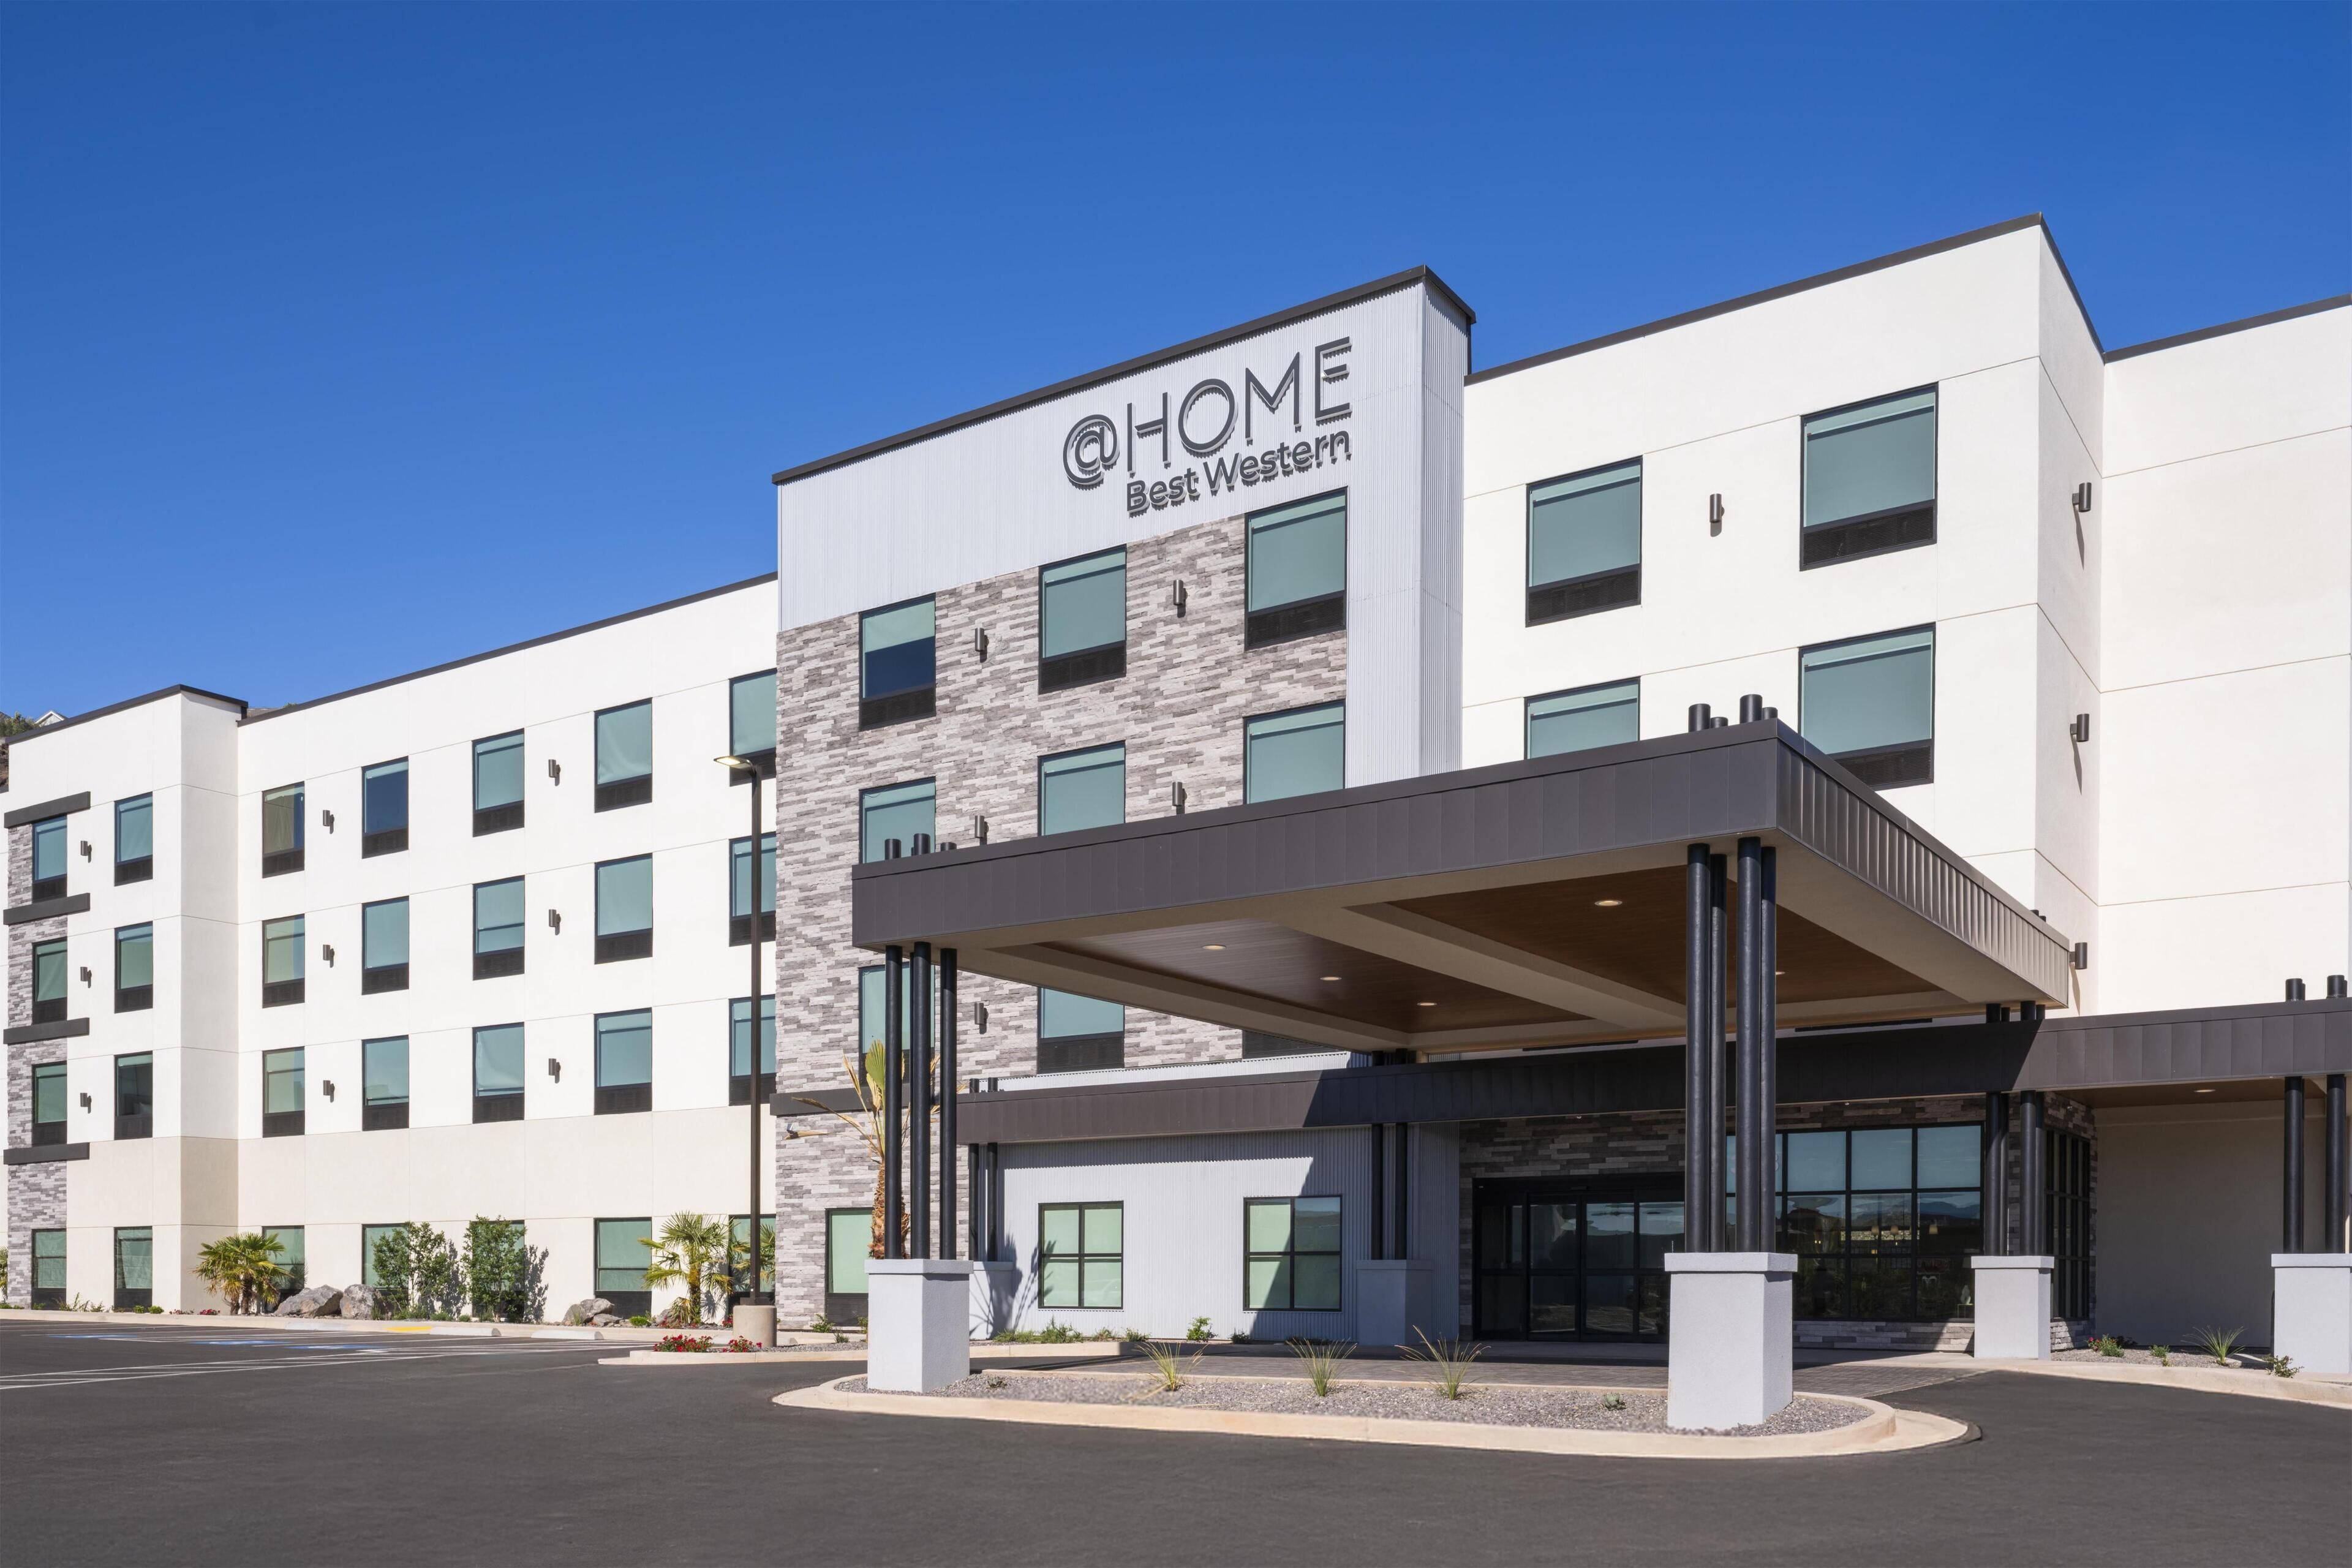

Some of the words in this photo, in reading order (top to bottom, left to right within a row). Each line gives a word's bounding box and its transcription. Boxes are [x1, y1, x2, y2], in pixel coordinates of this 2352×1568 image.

[1063, 336, 1351, 484] @HOME
[1127, 467, 1198, 513] Best
[1203, 431, 1351, 491] Western
